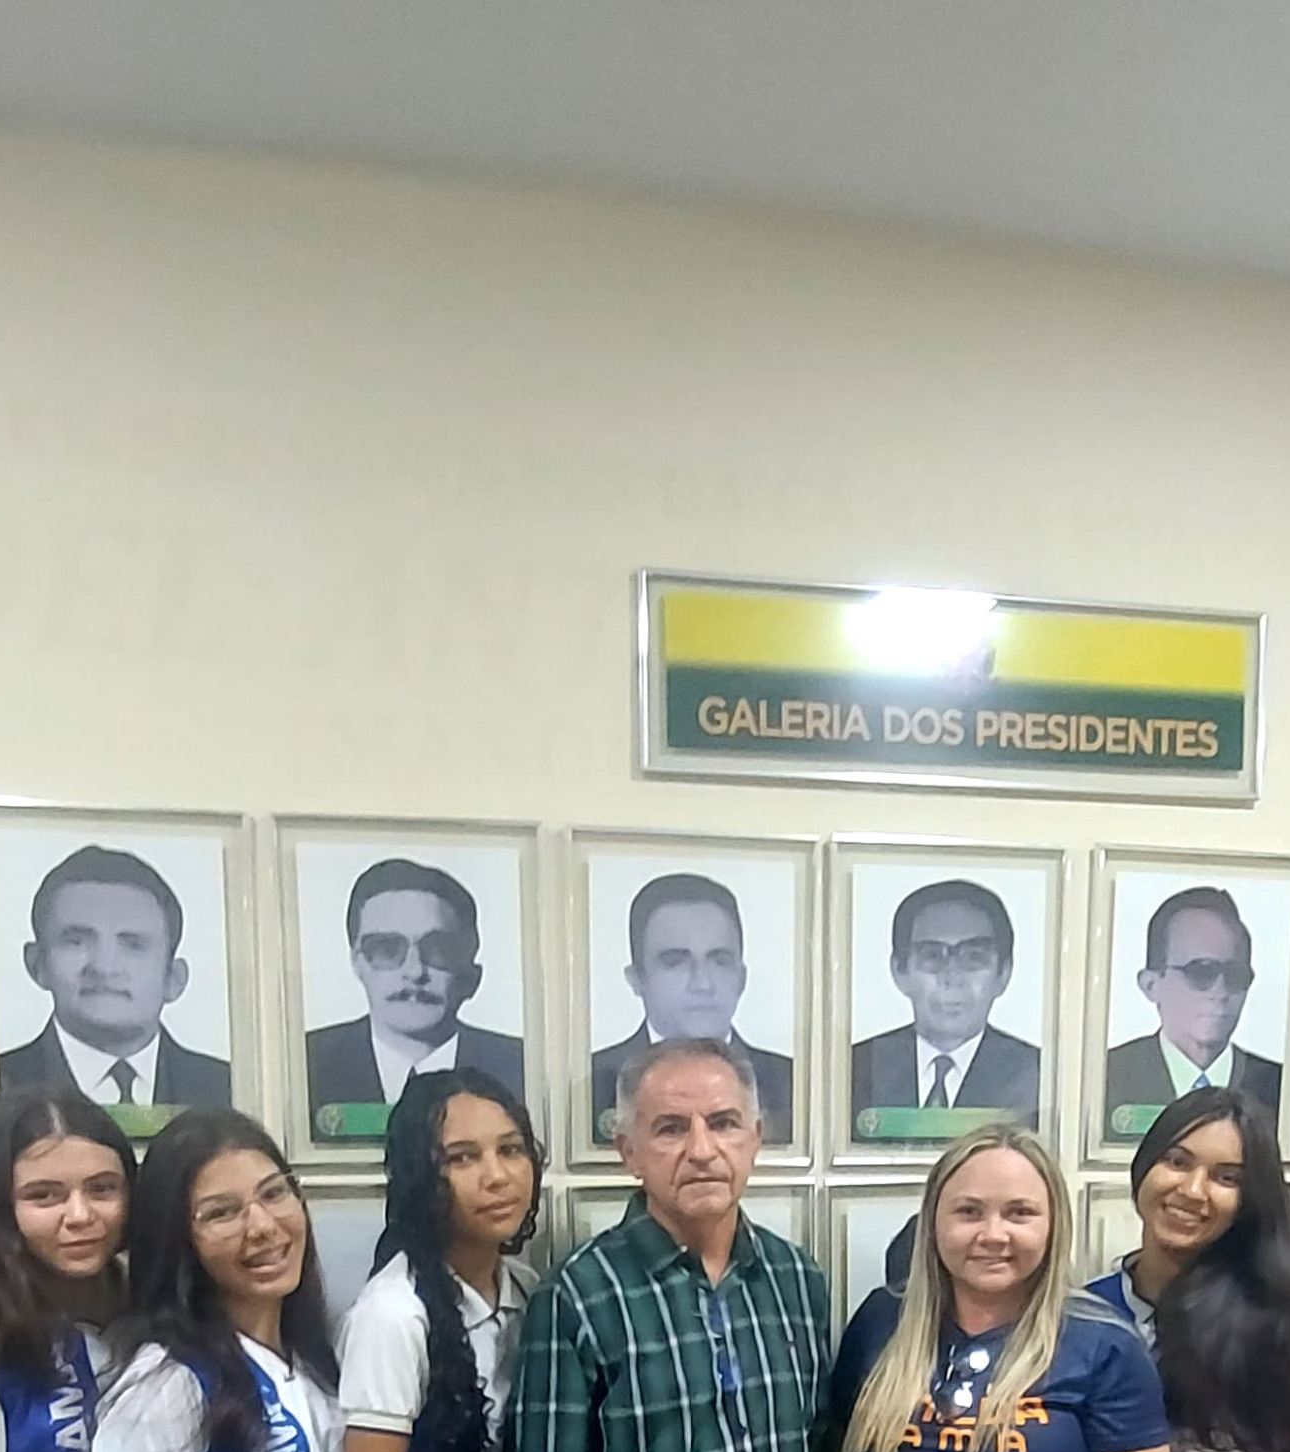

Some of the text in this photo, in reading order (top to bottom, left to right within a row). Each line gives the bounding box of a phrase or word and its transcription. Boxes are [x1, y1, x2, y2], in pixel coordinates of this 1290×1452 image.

[698, 695, 1219, 758] GALERIA DOS PRESIDENTES
